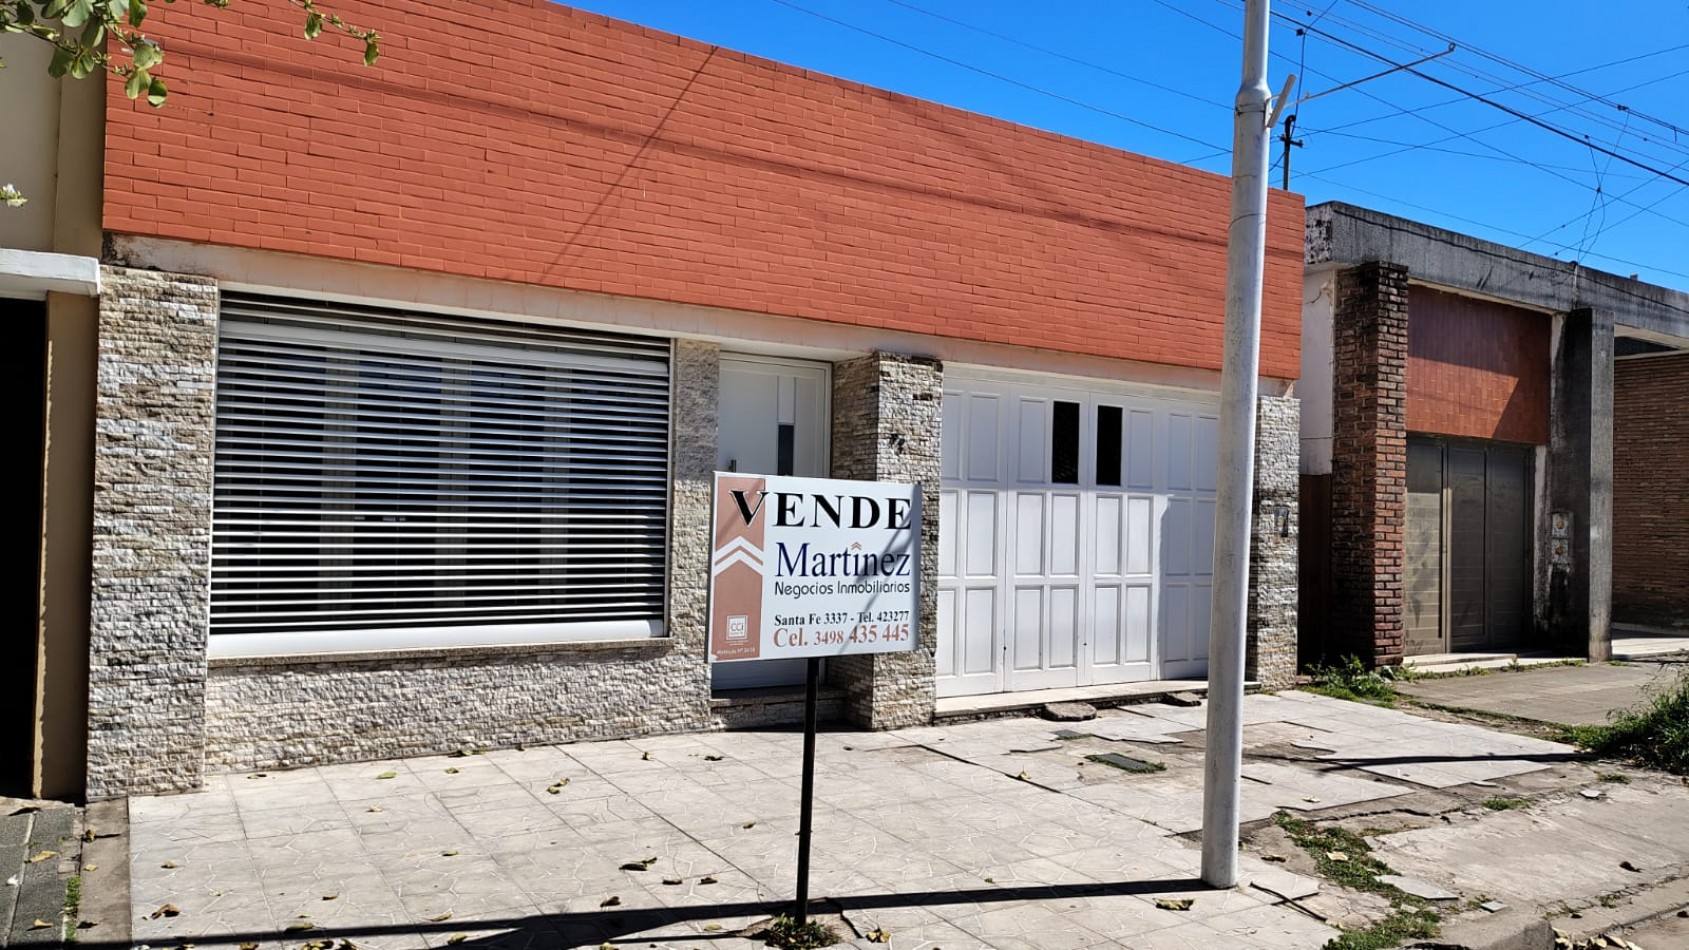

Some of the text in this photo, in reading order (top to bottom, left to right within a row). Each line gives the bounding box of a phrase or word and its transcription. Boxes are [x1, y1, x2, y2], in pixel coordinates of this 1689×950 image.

[730, 490, 913, 530] VENDE
[774, 580, 910, 599] Negocios Inmobiliarios
[774, 613, 805, 626] Santa
[809, 613, 821, 625] Fe
[823, 612, 848, 624] 3337
[858, 611, 875, 623] Tel.
[876, 610, 909, 622] 423277
[773, 623, 909, 647] Cel. 3498 435 445
